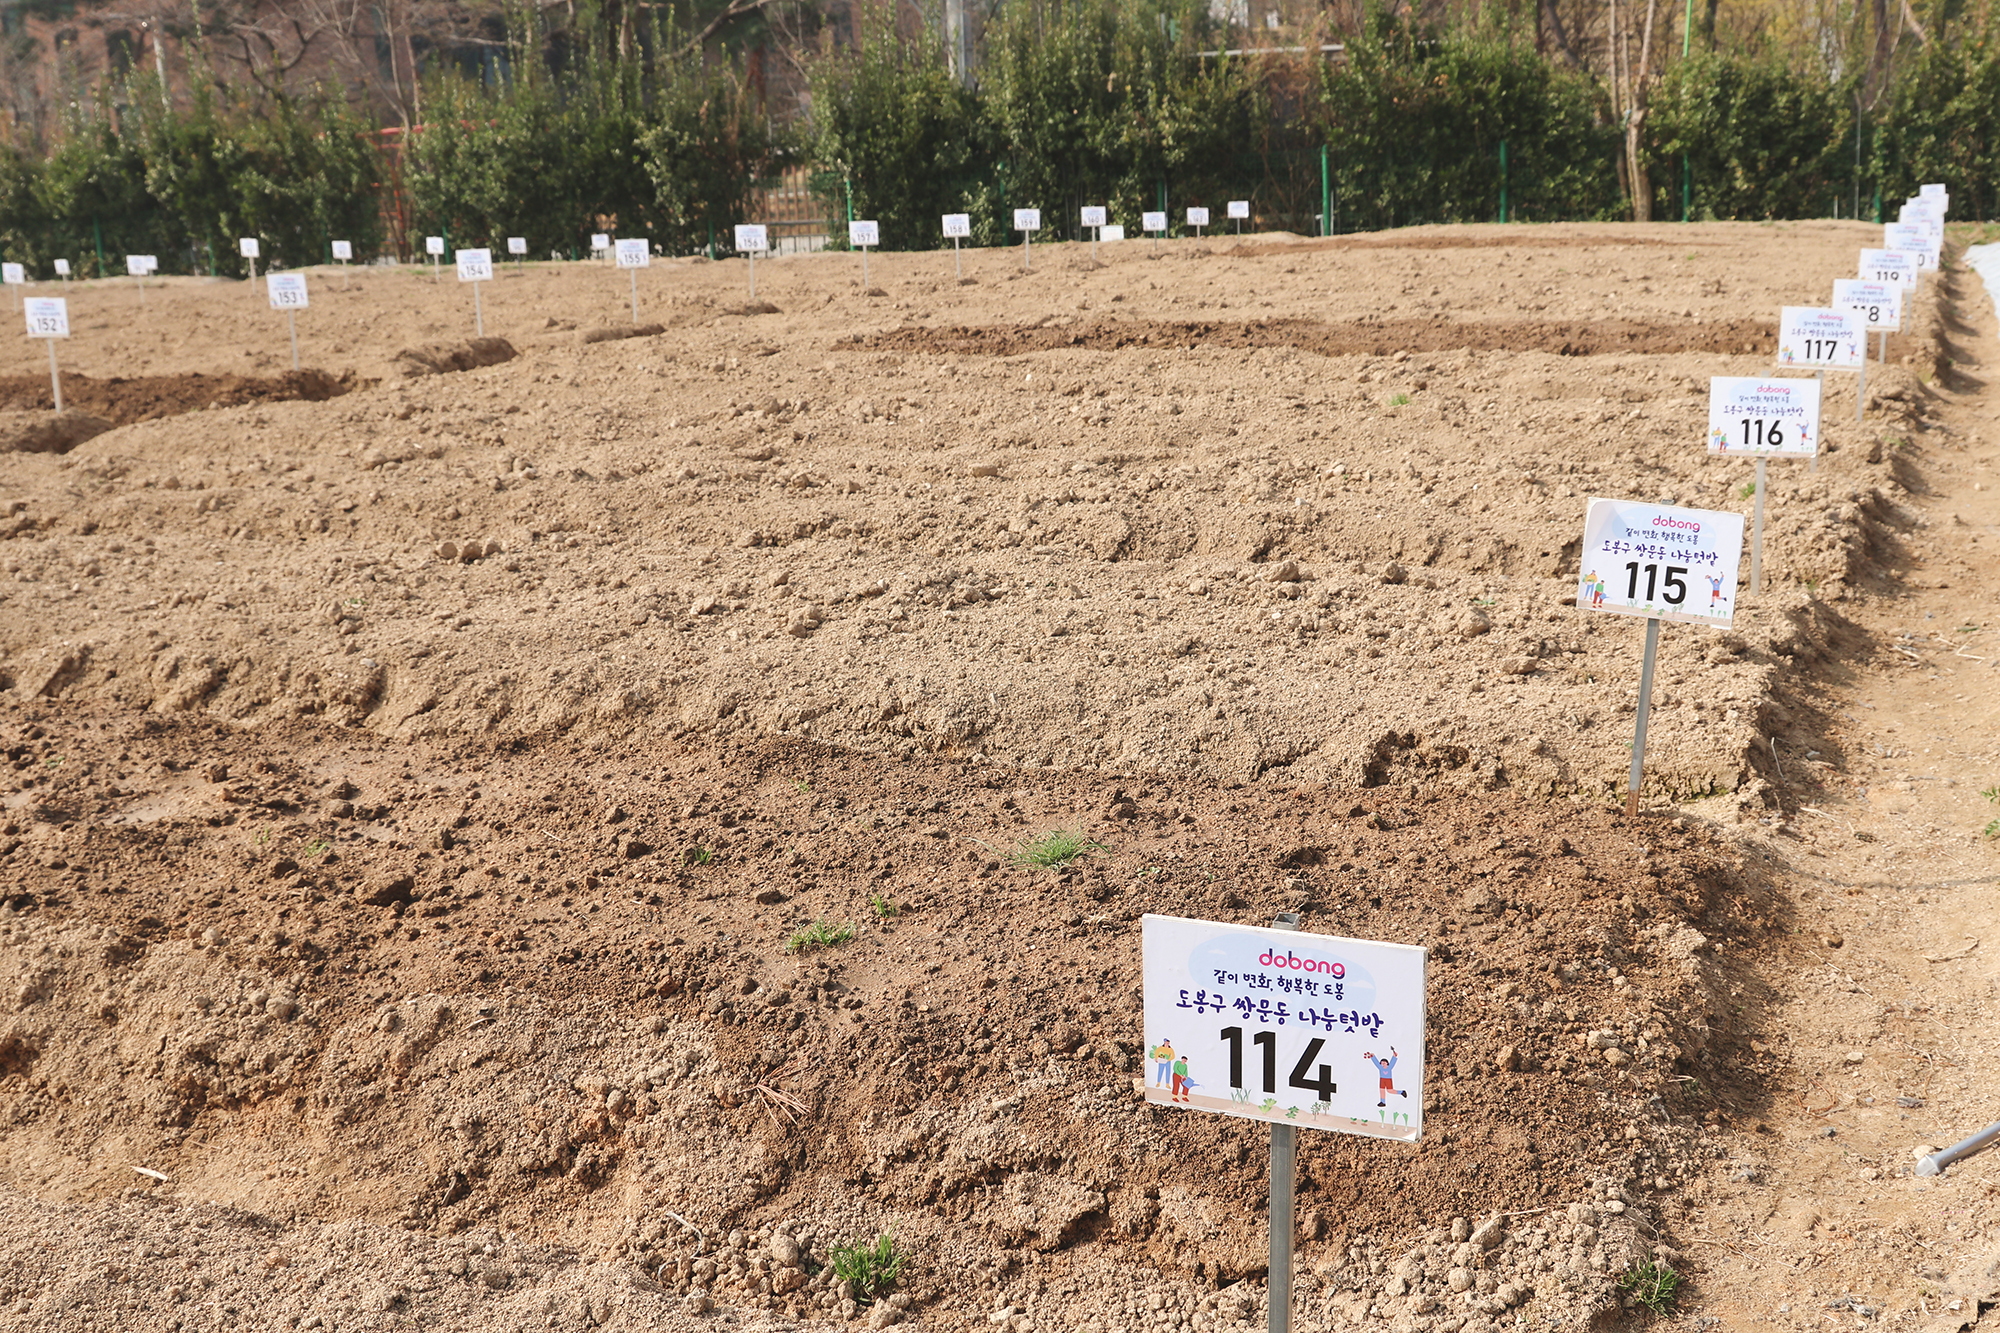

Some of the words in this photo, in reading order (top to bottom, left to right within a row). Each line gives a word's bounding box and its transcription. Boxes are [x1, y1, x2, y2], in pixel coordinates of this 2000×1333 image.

[857, 233, 871, 242] 157
[950, 225, 963, 234] 158
[743, 238, 758, 248] 156
[624, 253, 641, 264] 155
[466, 264, 483, 275] 154
[278, 291, 297, 304] 153
[37, 317, 57, 331] 152
[1805, 339, 1838, 360] 117
[1757, 385, 1790, 395] dobong
[1741, 419, 1783, 446] 116
[1652, 515, 1700, 533] dobong
[1625, 527, 1640, 538] 같이
[1661, 531, 1685, 543] 행복한
[1687, 534, 1699, 546] 도봉
[1602, 540, 1631, 555] 도봉구
[1634, 543, 1667, 560] 쌍문동
[1671, 549, 1719, 567] 나눔텃밭
[1626, 562, 1688, 604] 115
[1259, 948, 1345, 979] dobong
[1213, 969, 1238, 984] 같이
[1243, 972, 1273, 992] 변화,
[1277, 975, 1319, 997] 행복한
[1323, 982, 1344, 1001] 도봉
[1176, 989, 1226, 1014] 도봉구
[1232, 996, 1290, 1025] 쌍문동
[1299, 1007, 1384, 1039] 나눔텃밭
[1220, 1026, 1337, 1101] 114
